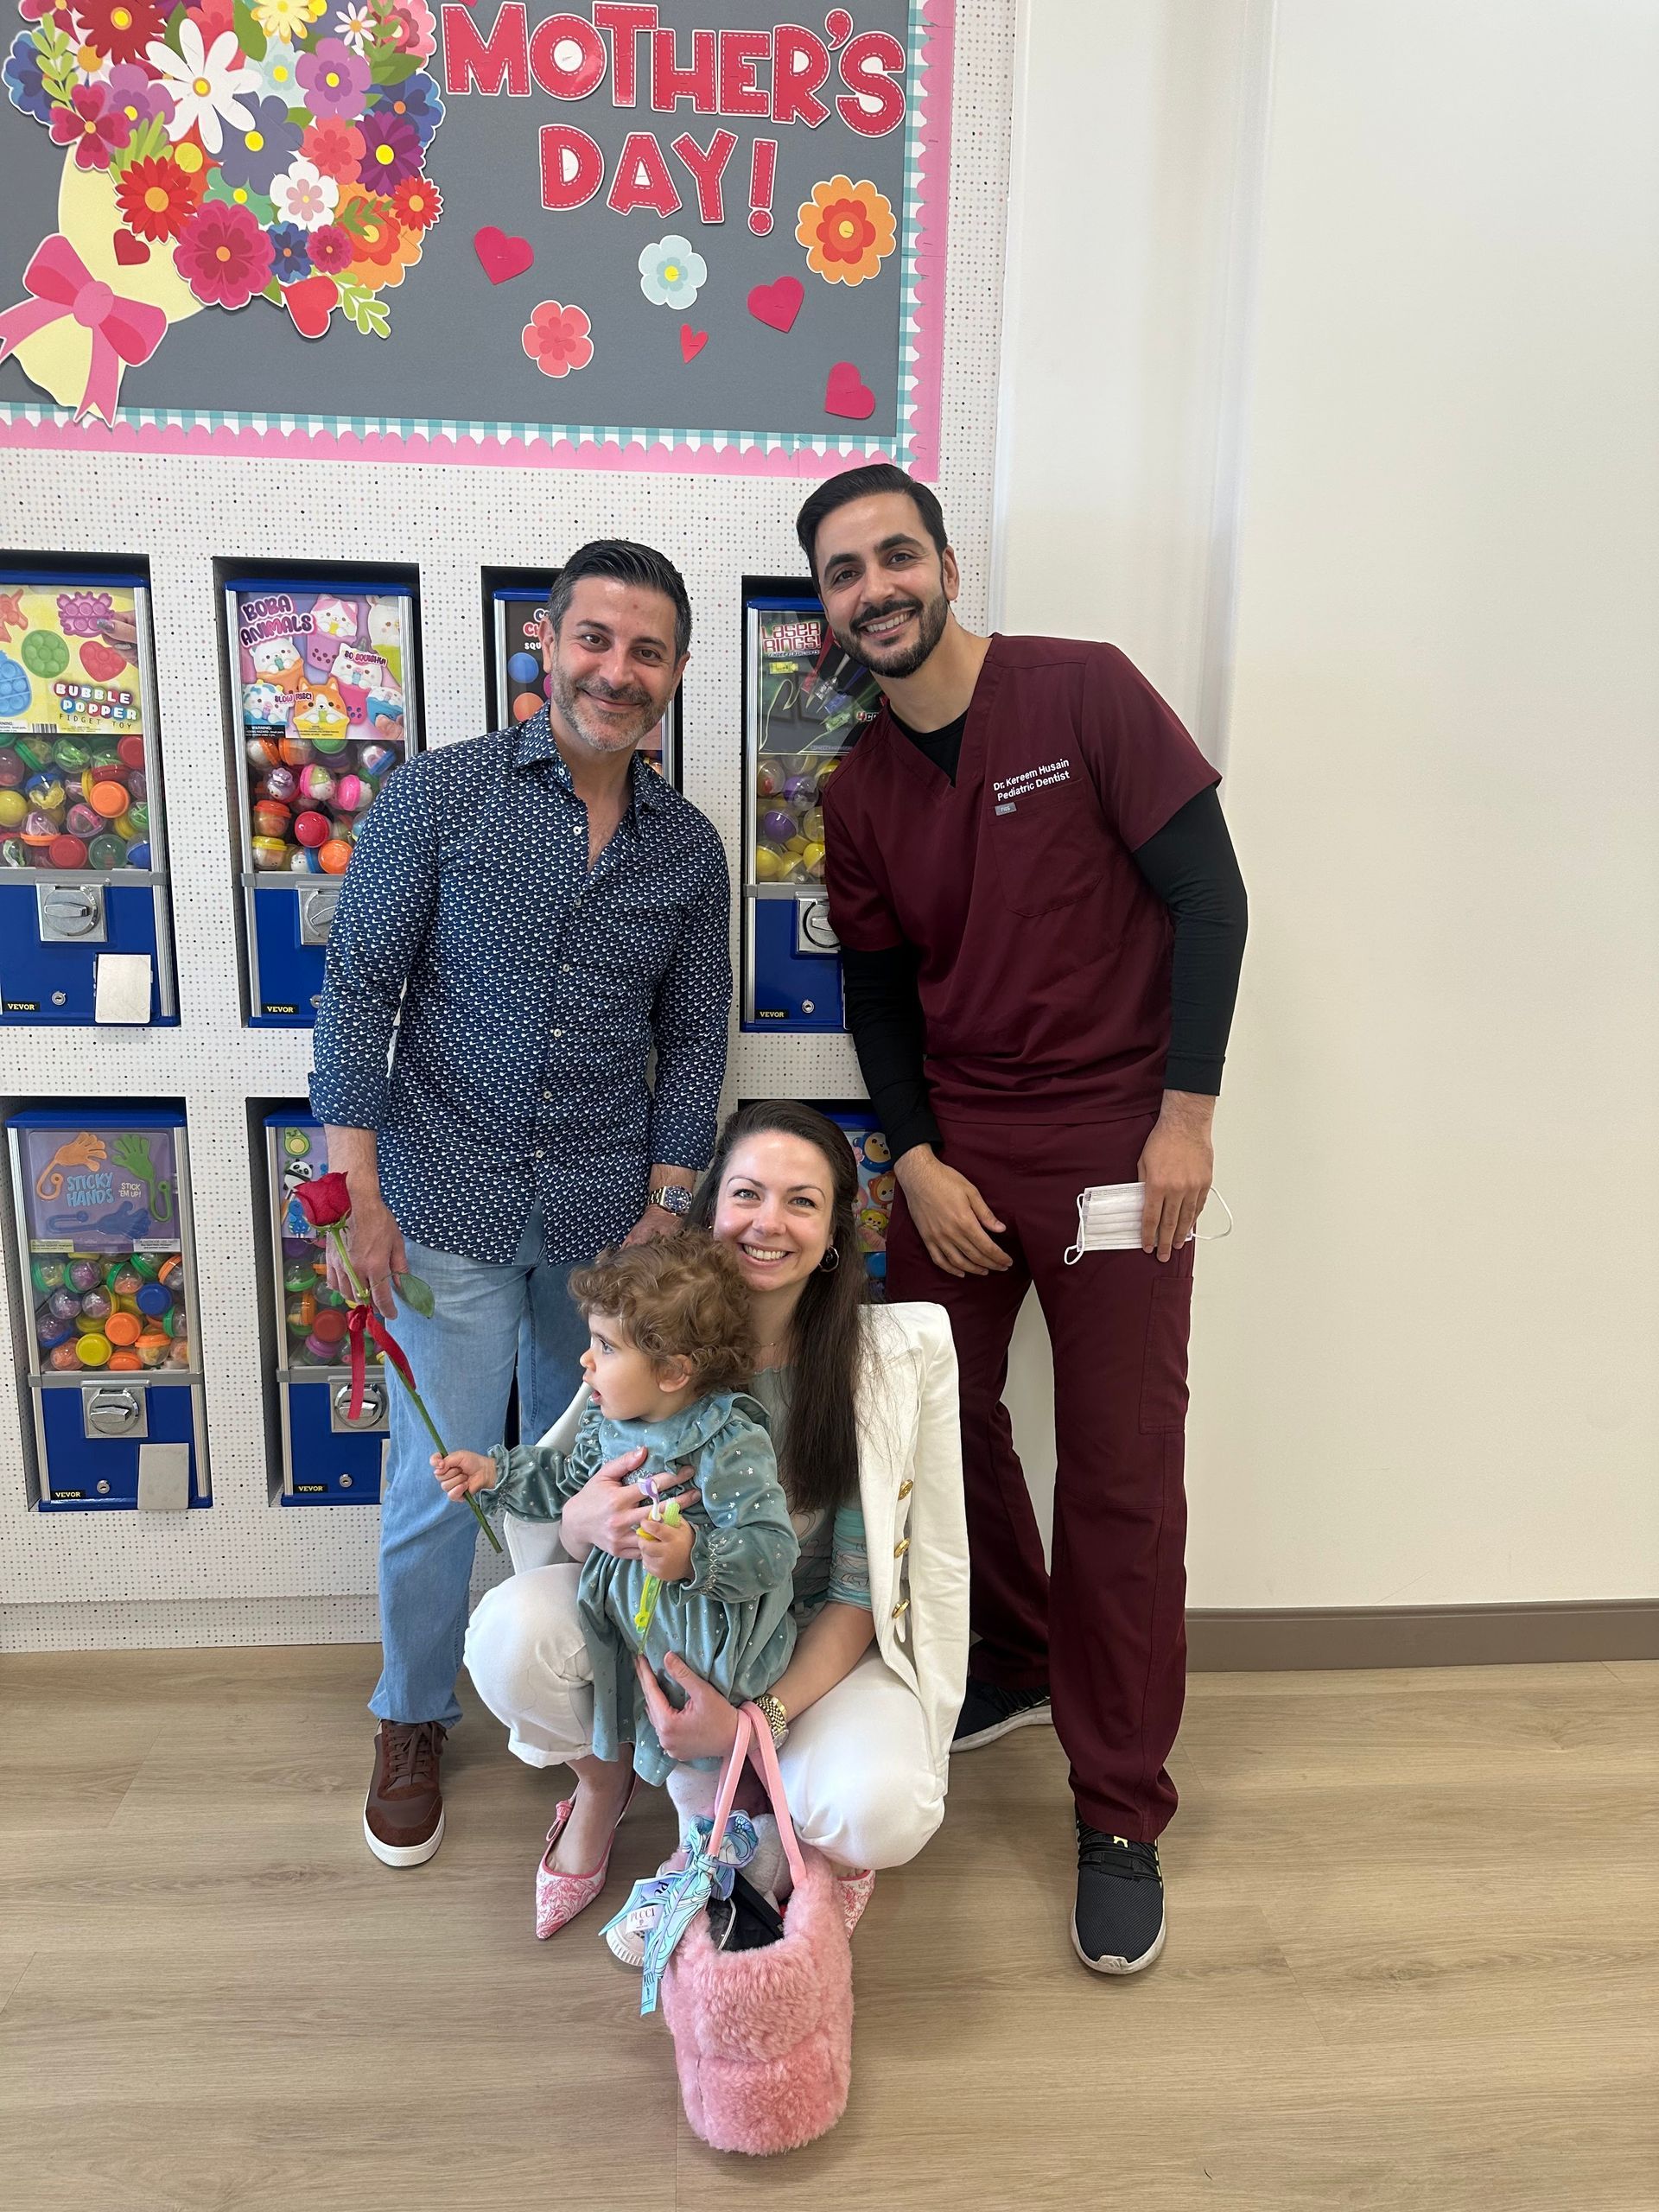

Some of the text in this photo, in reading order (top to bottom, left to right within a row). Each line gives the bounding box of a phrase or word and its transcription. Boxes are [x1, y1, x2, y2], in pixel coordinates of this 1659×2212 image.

[442, 2, 906, 137] MOTHER'S
[539, 124, 778, 237] DAY!
[242, 594, 293, 621] BOBA
[240, 614, 313, 646] ANIMALS
[55, 683, 131, 704] BUBBLE
[274, 694, 293, 702] SLOW
[62, 699, 137, 721] POPPER
[59, 713, 101, 725] FIDGET
[112, 721, 132, 730] TOY
[993, 759, 1070, 791] Dr. Kereem Husain
[997, 770, 1071, 801] Pediatric Dentist
[67, 1172, 113, 1191] STICKY
[121, 1182, 141, 1191] STICK
[67, 1188, 115, 1207] HANDS
[631, 1908, 655, 1922] PUCCI
